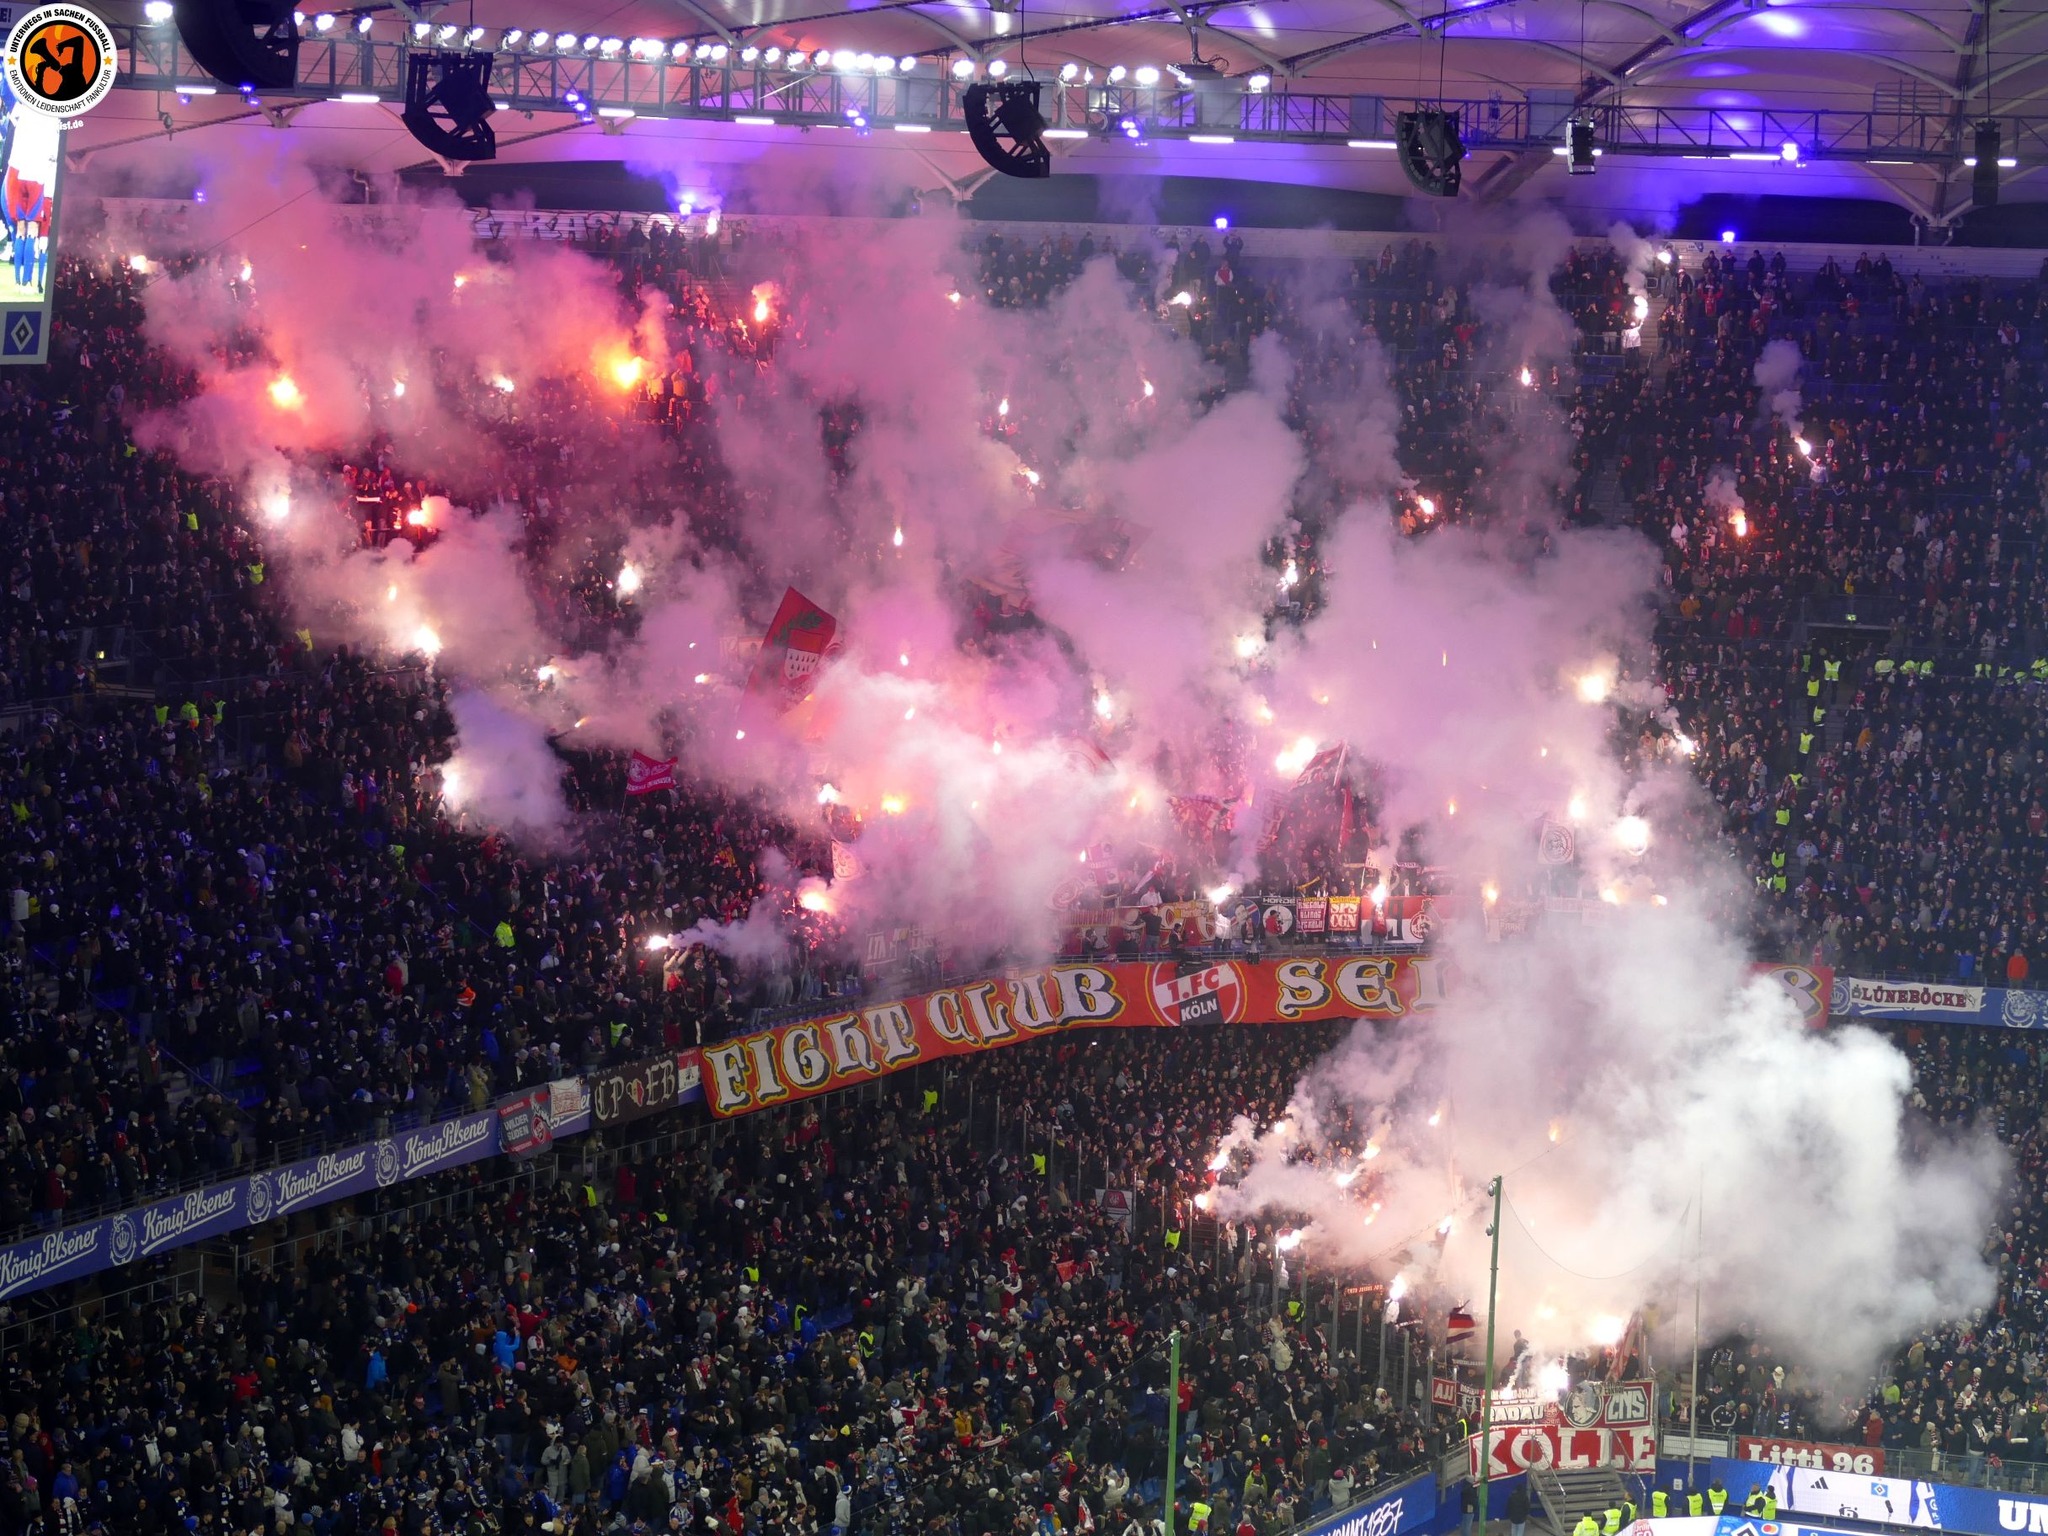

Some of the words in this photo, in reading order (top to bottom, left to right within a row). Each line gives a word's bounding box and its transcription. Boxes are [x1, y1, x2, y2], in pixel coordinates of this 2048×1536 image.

[1166, 967, 1219, 1003] 1.FC
[1861, 984, 1967, 1008] LÜNEBÖCKE
[1180, 998, 1218, 1021] KÖLN
[703, 1003, 917, 1111] FIGHT
[928, 967, 1125, 1046] CLUB
[503, 1113, 529, 1131] WILDER
[1748, 1444, 1824, 1470] Litti
[1832, 1452, 1874, 1475] 96
